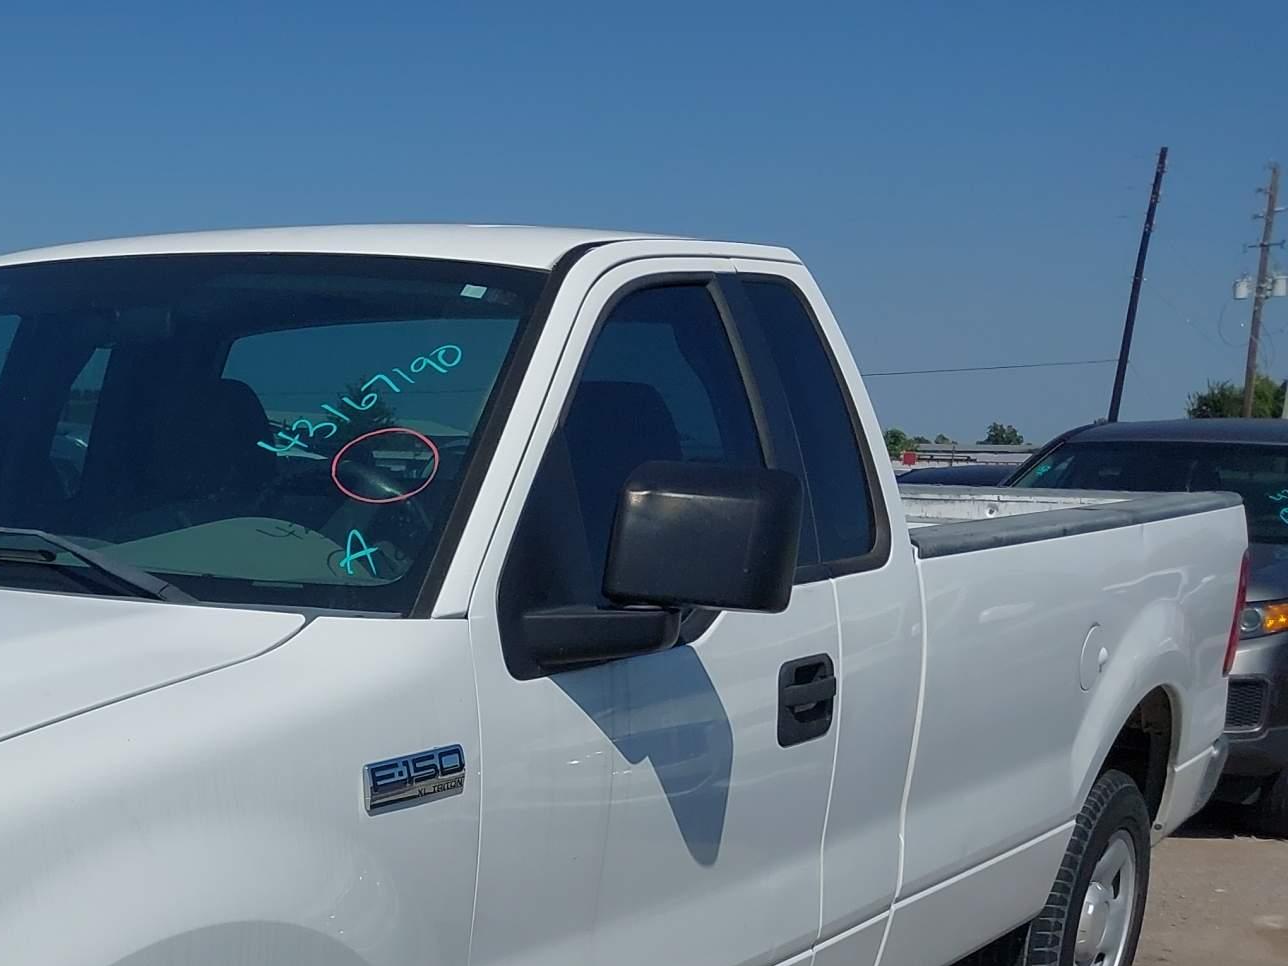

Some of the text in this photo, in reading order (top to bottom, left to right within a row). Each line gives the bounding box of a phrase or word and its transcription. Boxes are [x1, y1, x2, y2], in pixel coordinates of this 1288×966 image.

[257, 345, 462, 451] 43167190
[339, 529, 378, 576] A
[370, 748, 465, 793] F-150
